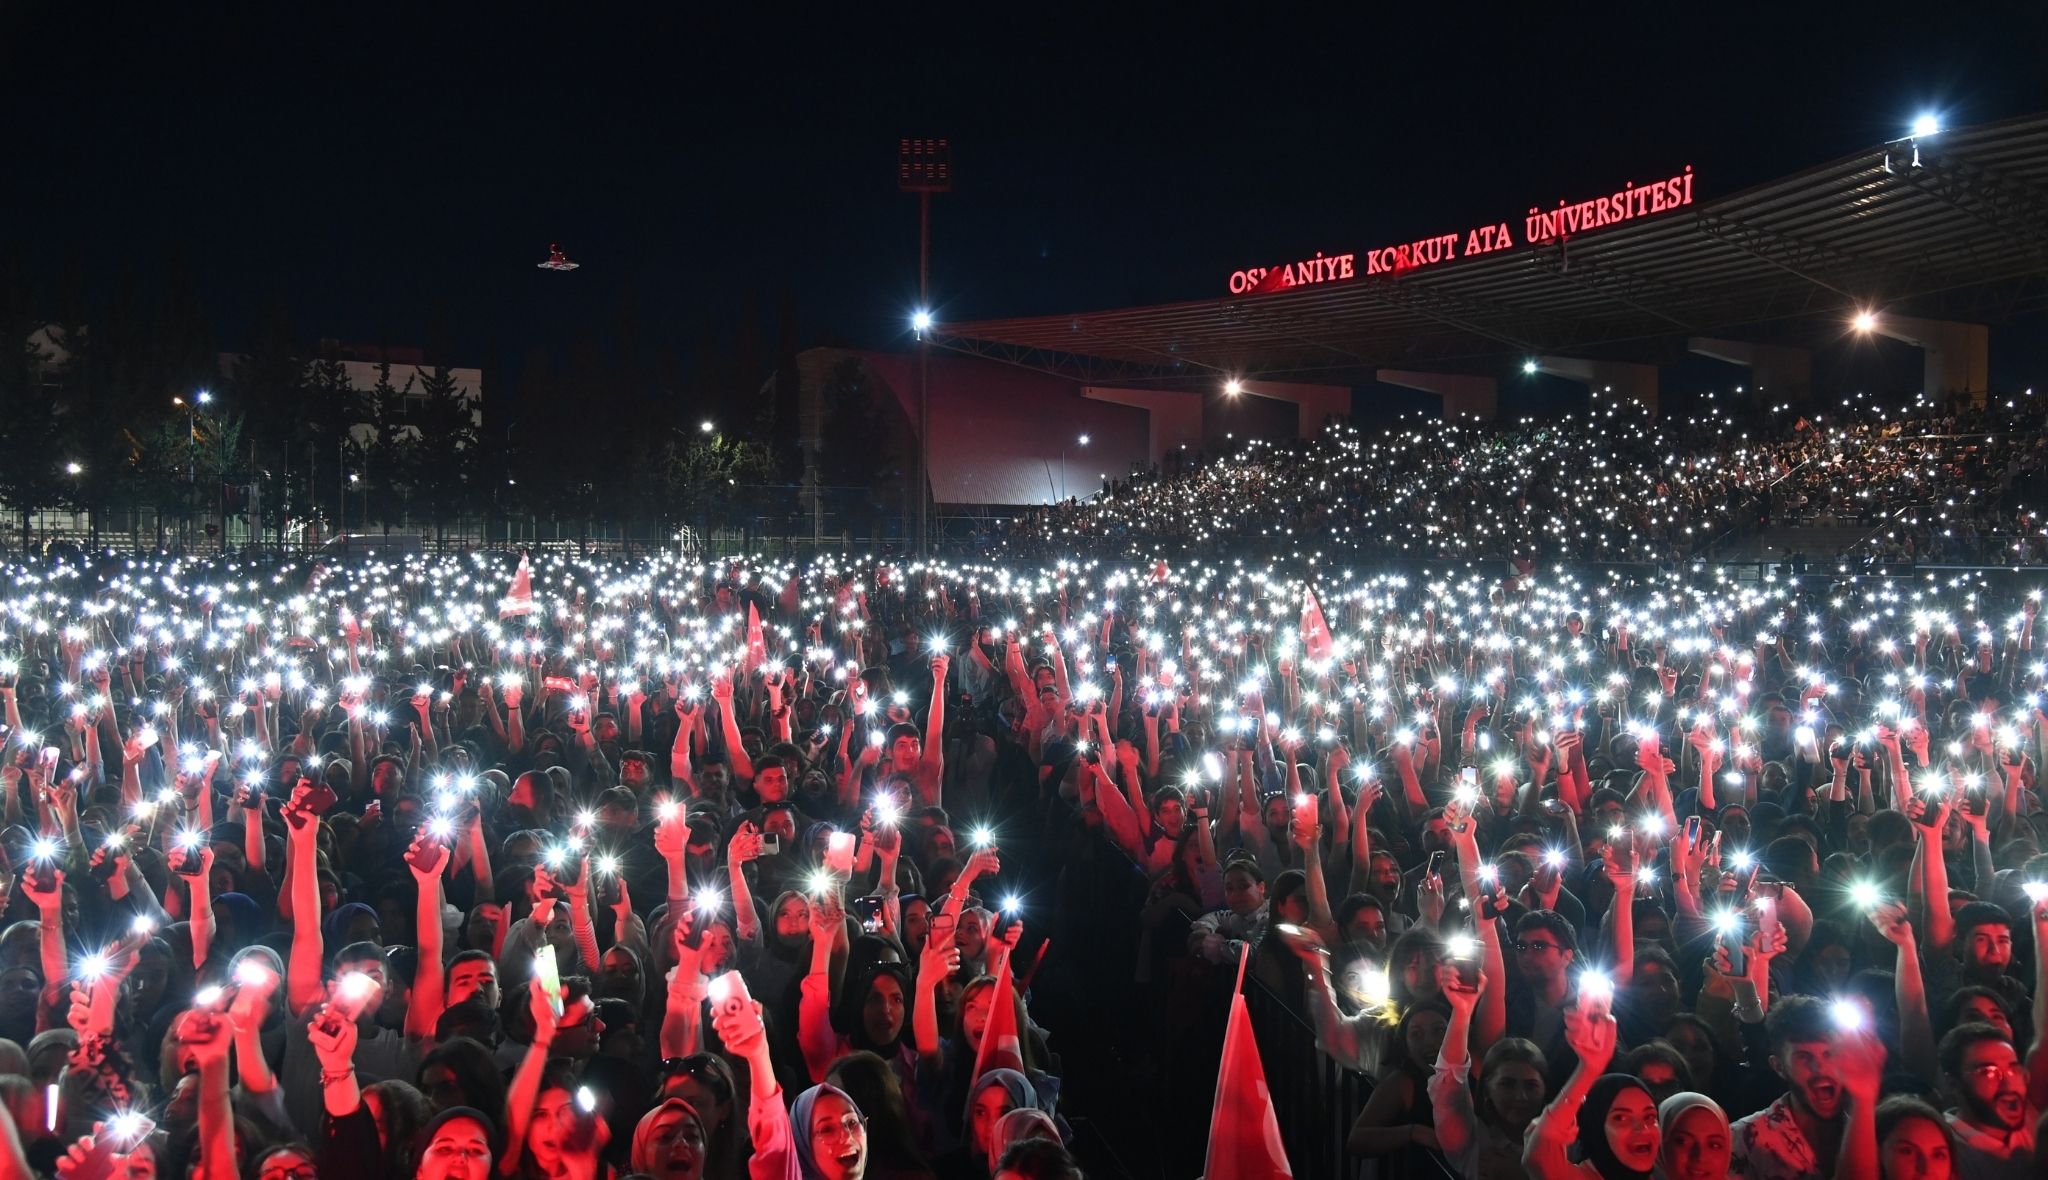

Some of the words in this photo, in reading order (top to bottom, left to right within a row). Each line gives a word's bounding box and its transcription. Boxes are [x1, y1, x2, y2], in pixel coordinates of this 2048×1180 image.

[1230, 252, 1354, 293] OSANİYE
[1367, 234, 1459, 275] KORKUT
[1465, 223, 1512, 256] ATA
[1526, 165, 1694, 243] ÜNİVERSİTESİ
